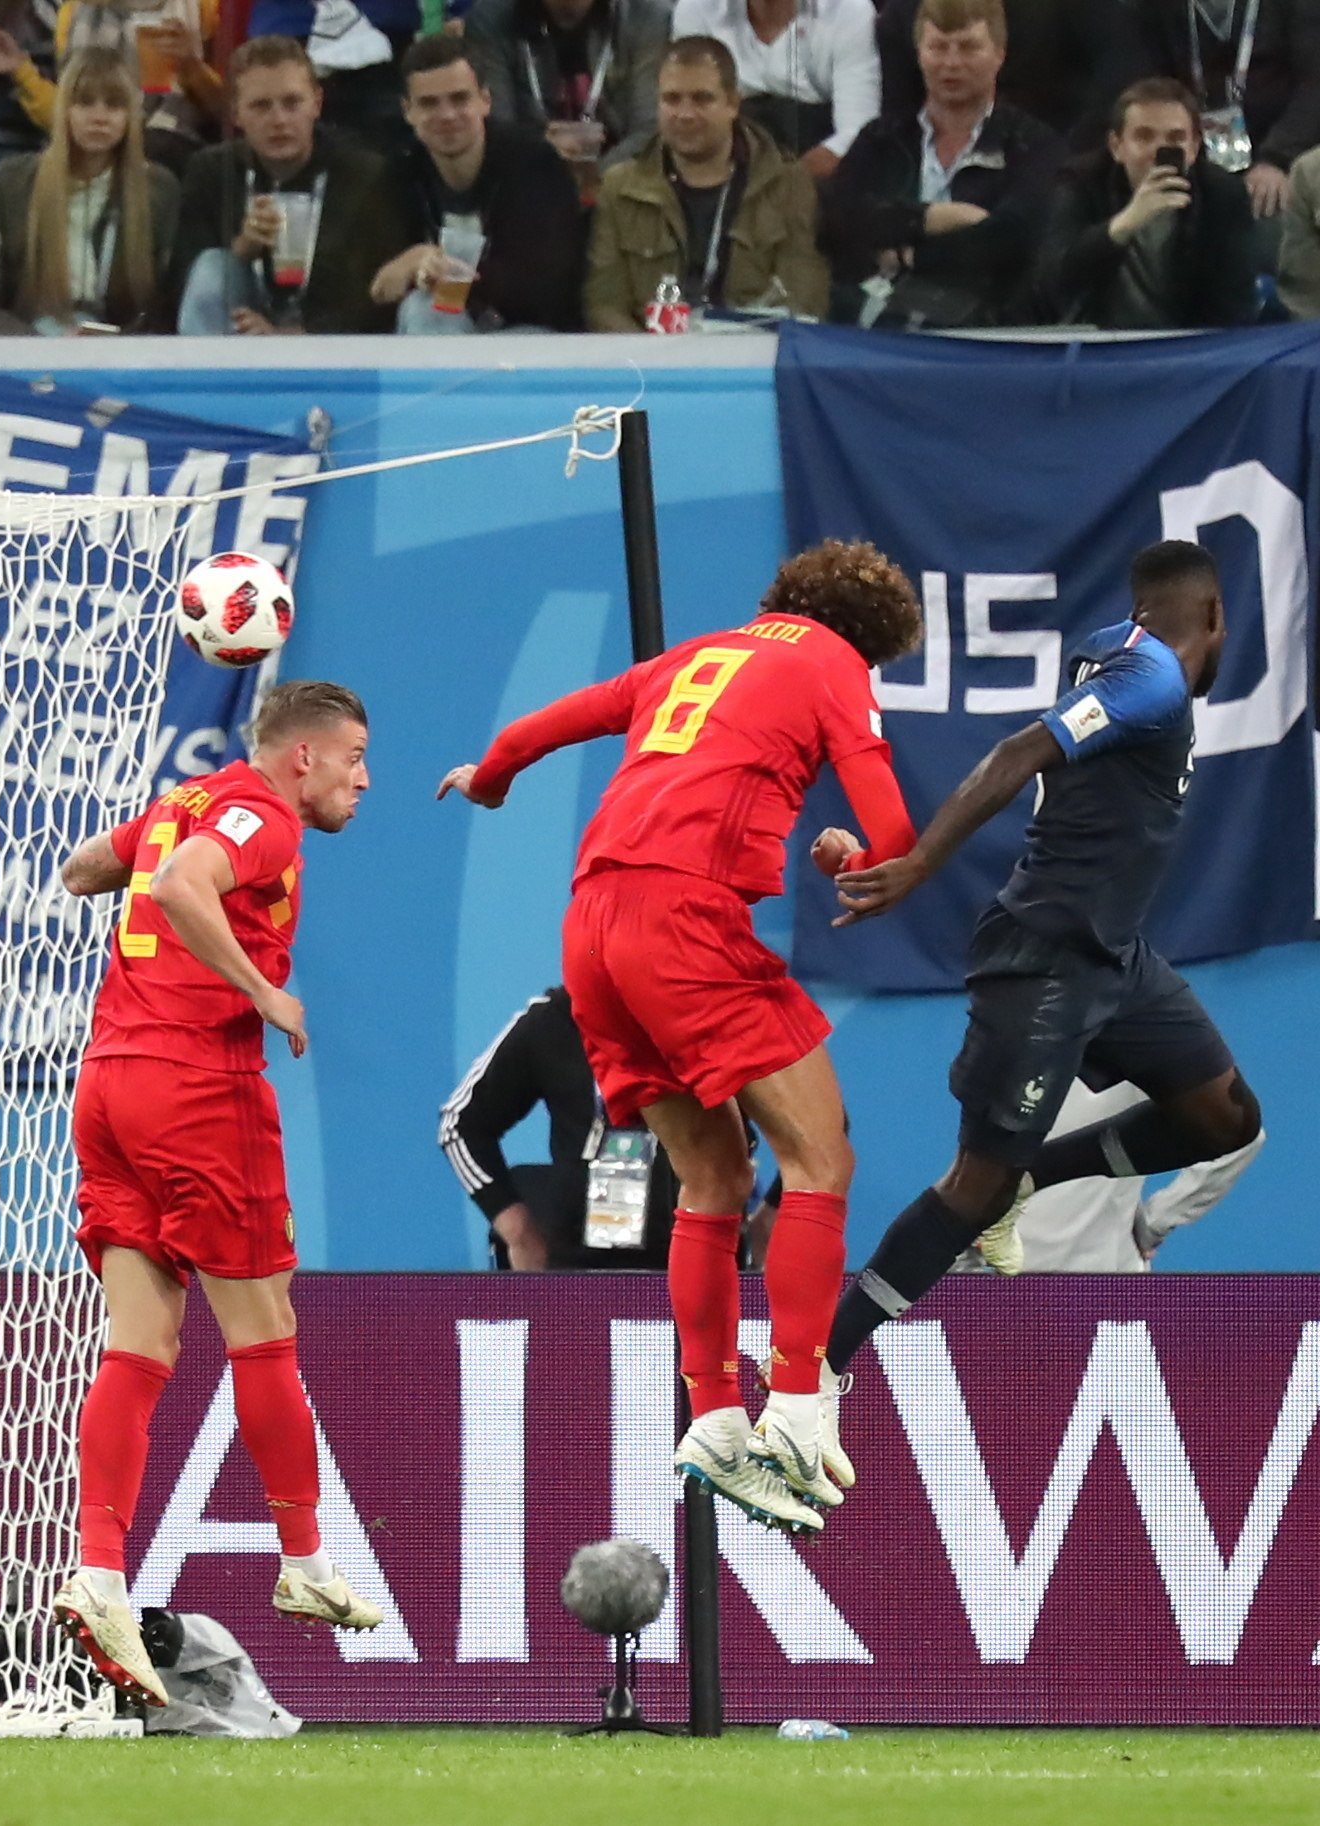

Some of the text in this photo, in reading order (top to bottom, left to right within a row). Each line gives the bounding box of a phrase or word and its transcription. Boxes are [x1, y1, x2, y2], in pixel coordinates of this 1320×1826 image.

[638, 647, 756, 754] 8
[118, 821, 178, 957] 2
[130, 1318, 1320, 1664] AIRW
